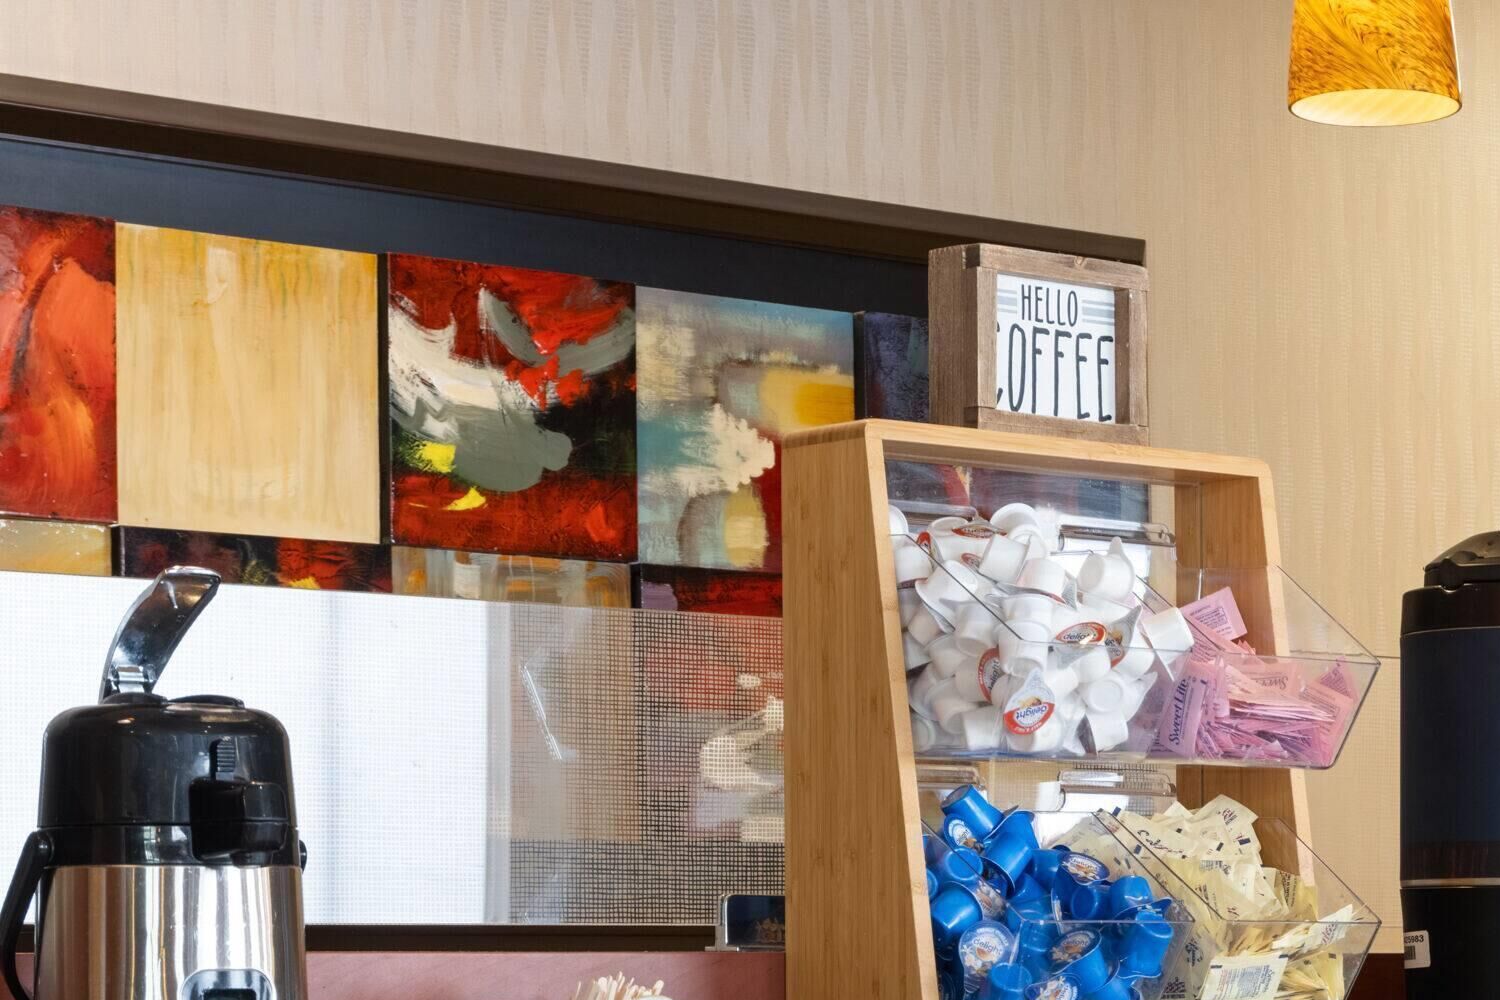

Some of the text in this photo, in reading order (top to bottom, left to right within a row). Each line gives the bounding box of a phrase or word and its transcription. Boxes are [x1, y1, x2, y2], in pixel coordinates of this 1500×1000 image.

[1021, 284, 1079, 326] HELLO
[1015, 704, 1048, 720] delight
[1168, 704, 1183, 746] Sweet
